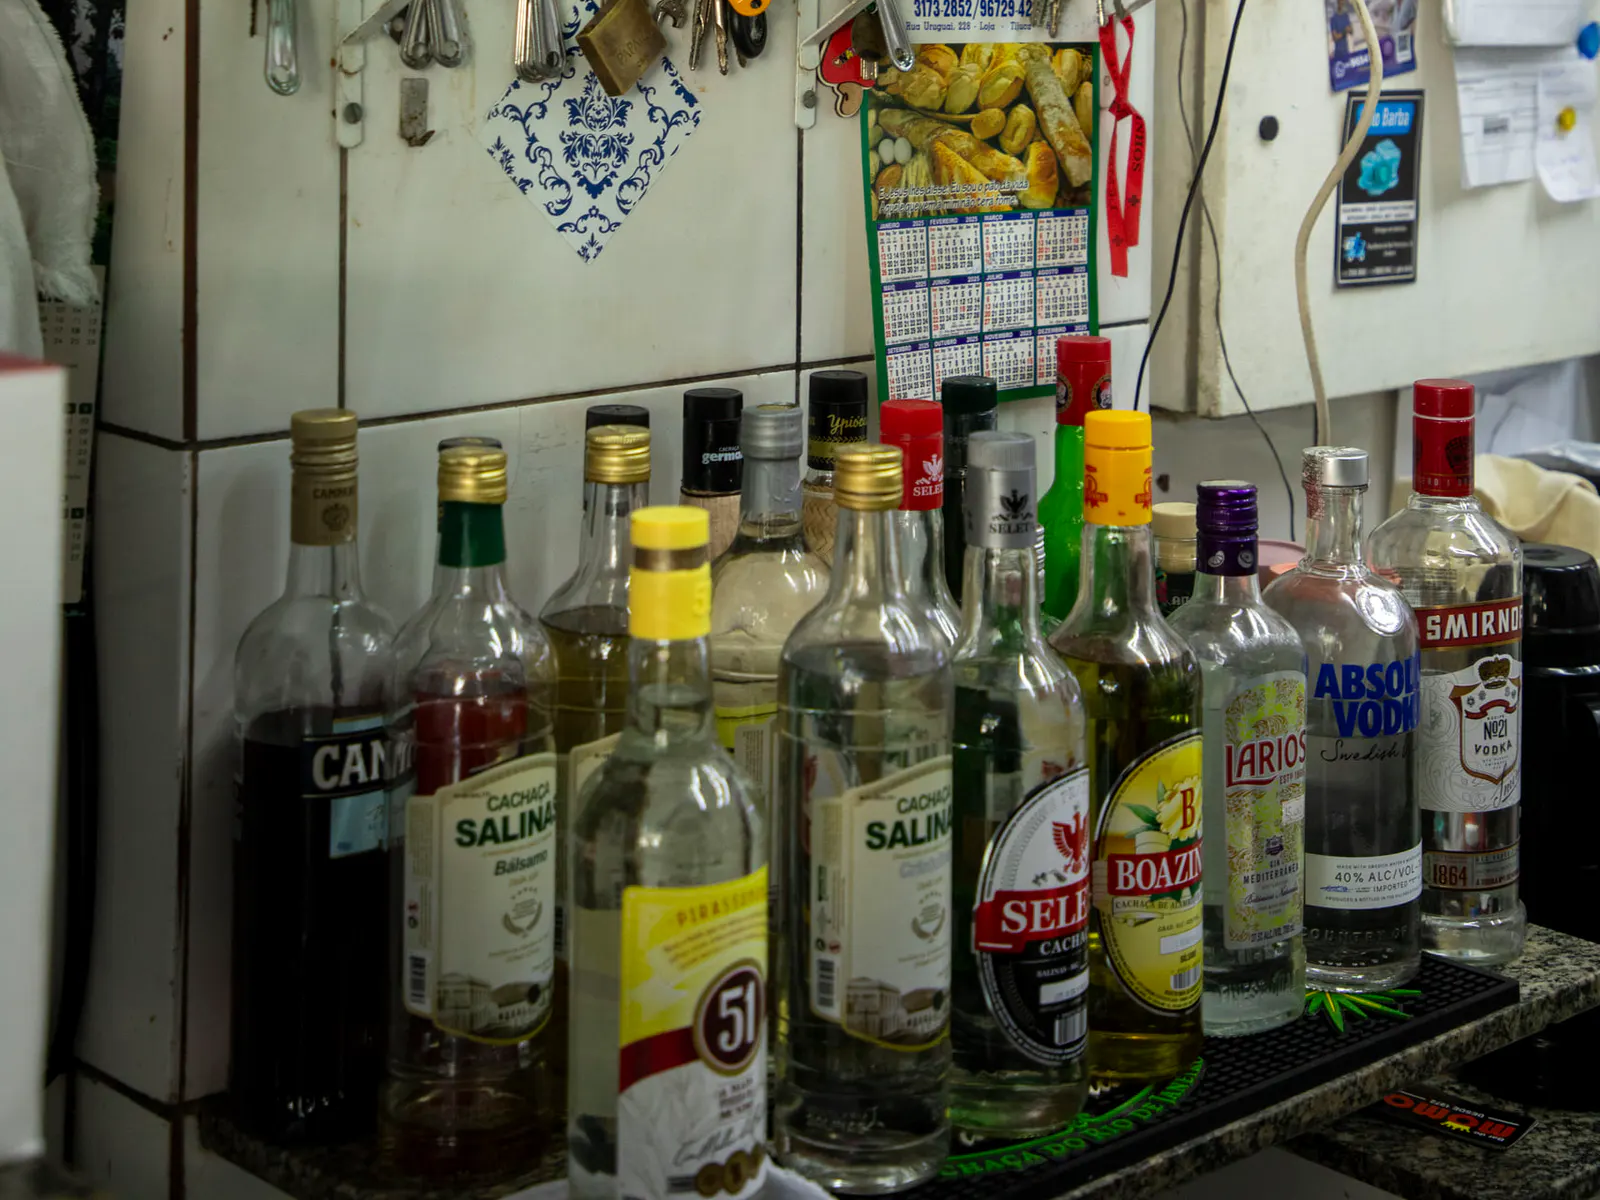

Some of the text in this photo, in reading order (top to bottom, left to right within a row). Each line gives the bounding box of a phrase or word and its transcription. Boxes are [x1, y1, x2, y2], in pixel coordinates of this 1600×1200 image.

[906, 21, 921, 31] Rua
[979, 21, 995, 32] Loja
[1010, 21, 1032, 31] Tijuca
[1225, 728, 1306, 788] LARIOS
[1320, 738, 1399, 762] Swedish
[1474, 739, 1513, 756] VODKA
[486, 781, 551, 812] CACHAÇA
[1180, 787, 1196, 831] B
[1334, 872, 1364, 883] 40%
[1373, 881, 1408, 893] IMPORTED
[1433, 863, 1467, 887] 1864
[718, 980, 756, 1053] 51
[1383, 1093, 1517, 1138] momo
